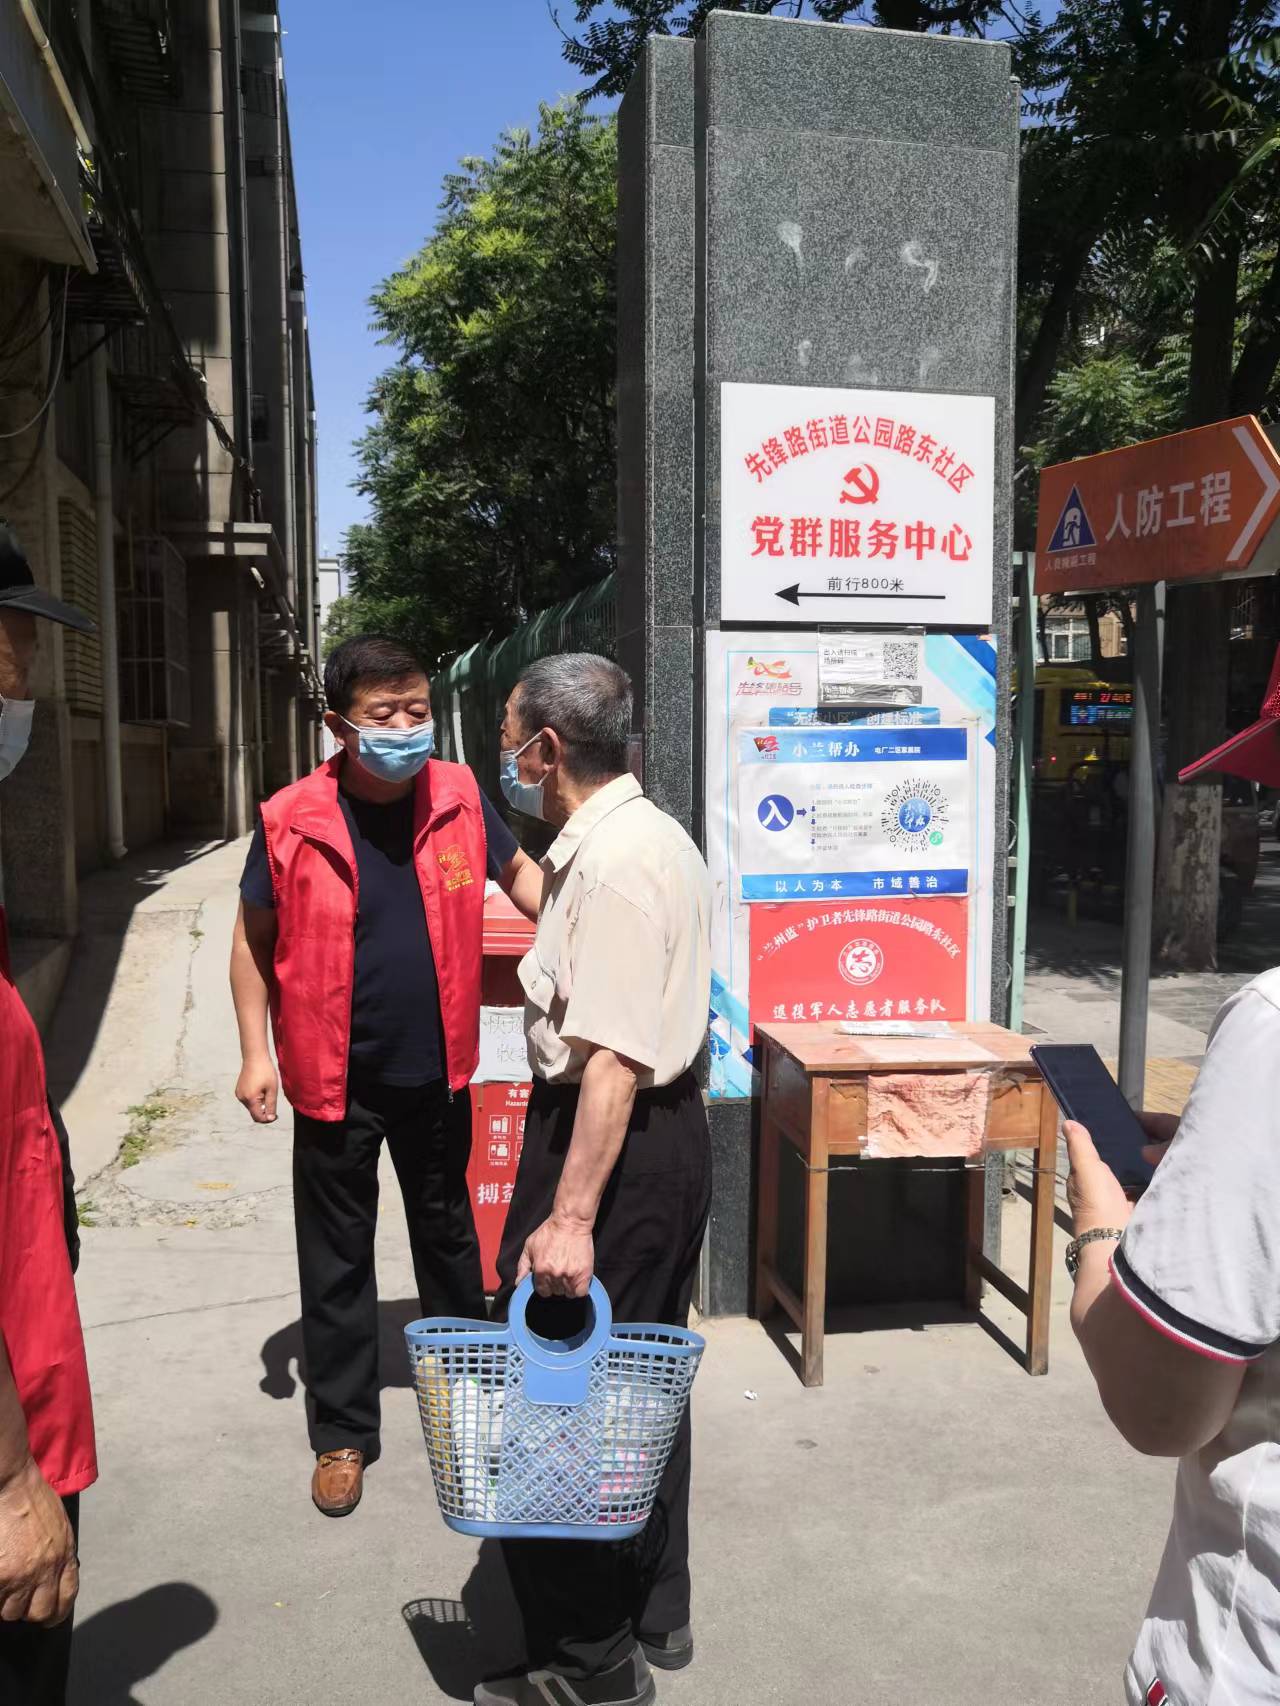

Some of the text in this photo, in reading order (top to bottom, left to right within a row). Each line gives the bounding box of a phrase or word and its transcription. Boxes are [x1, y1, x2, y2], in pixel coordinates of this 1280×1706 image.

[744, 414, 976, 494] 先锋路街道公园路东社区
[1105, 470, 1232, 542] 人防工程
[750, 515, 973, 561] 党群服务中心
[826, 576, 905, 592] 前行800米
[793, 741, 860, 758] 小兰帮办
[775, 880, 843, 893] 以人为本
[773, 997, 946, 1020] 退役军人志愿者服务队
